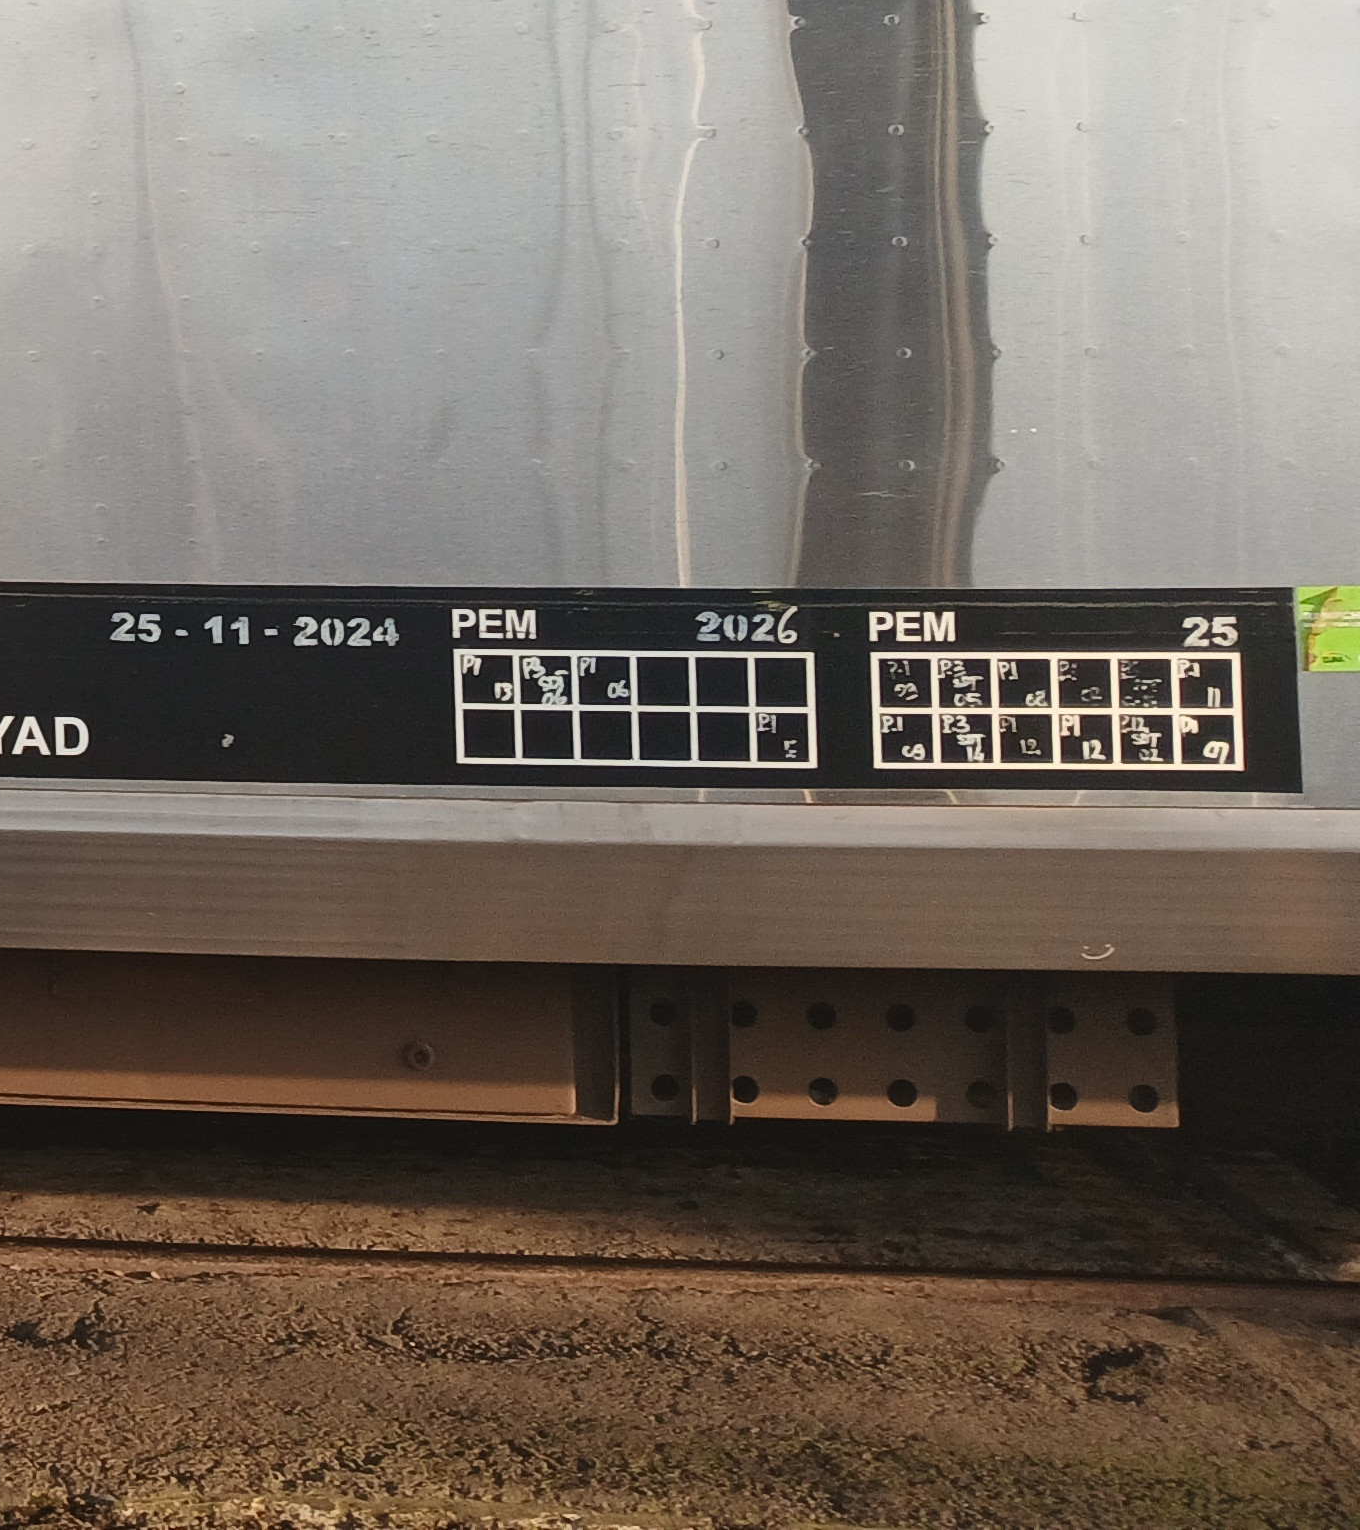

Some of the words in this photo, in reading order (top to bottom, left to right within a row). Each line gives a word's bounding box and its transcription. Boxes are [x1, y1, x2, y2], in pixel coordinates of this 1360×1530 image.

[452, 609, 537, 639] PEM
[695, 606, 798, 644] 2026
[869, 611, 955, 642] PEM
[1182, 617, 1239, 647] 25
